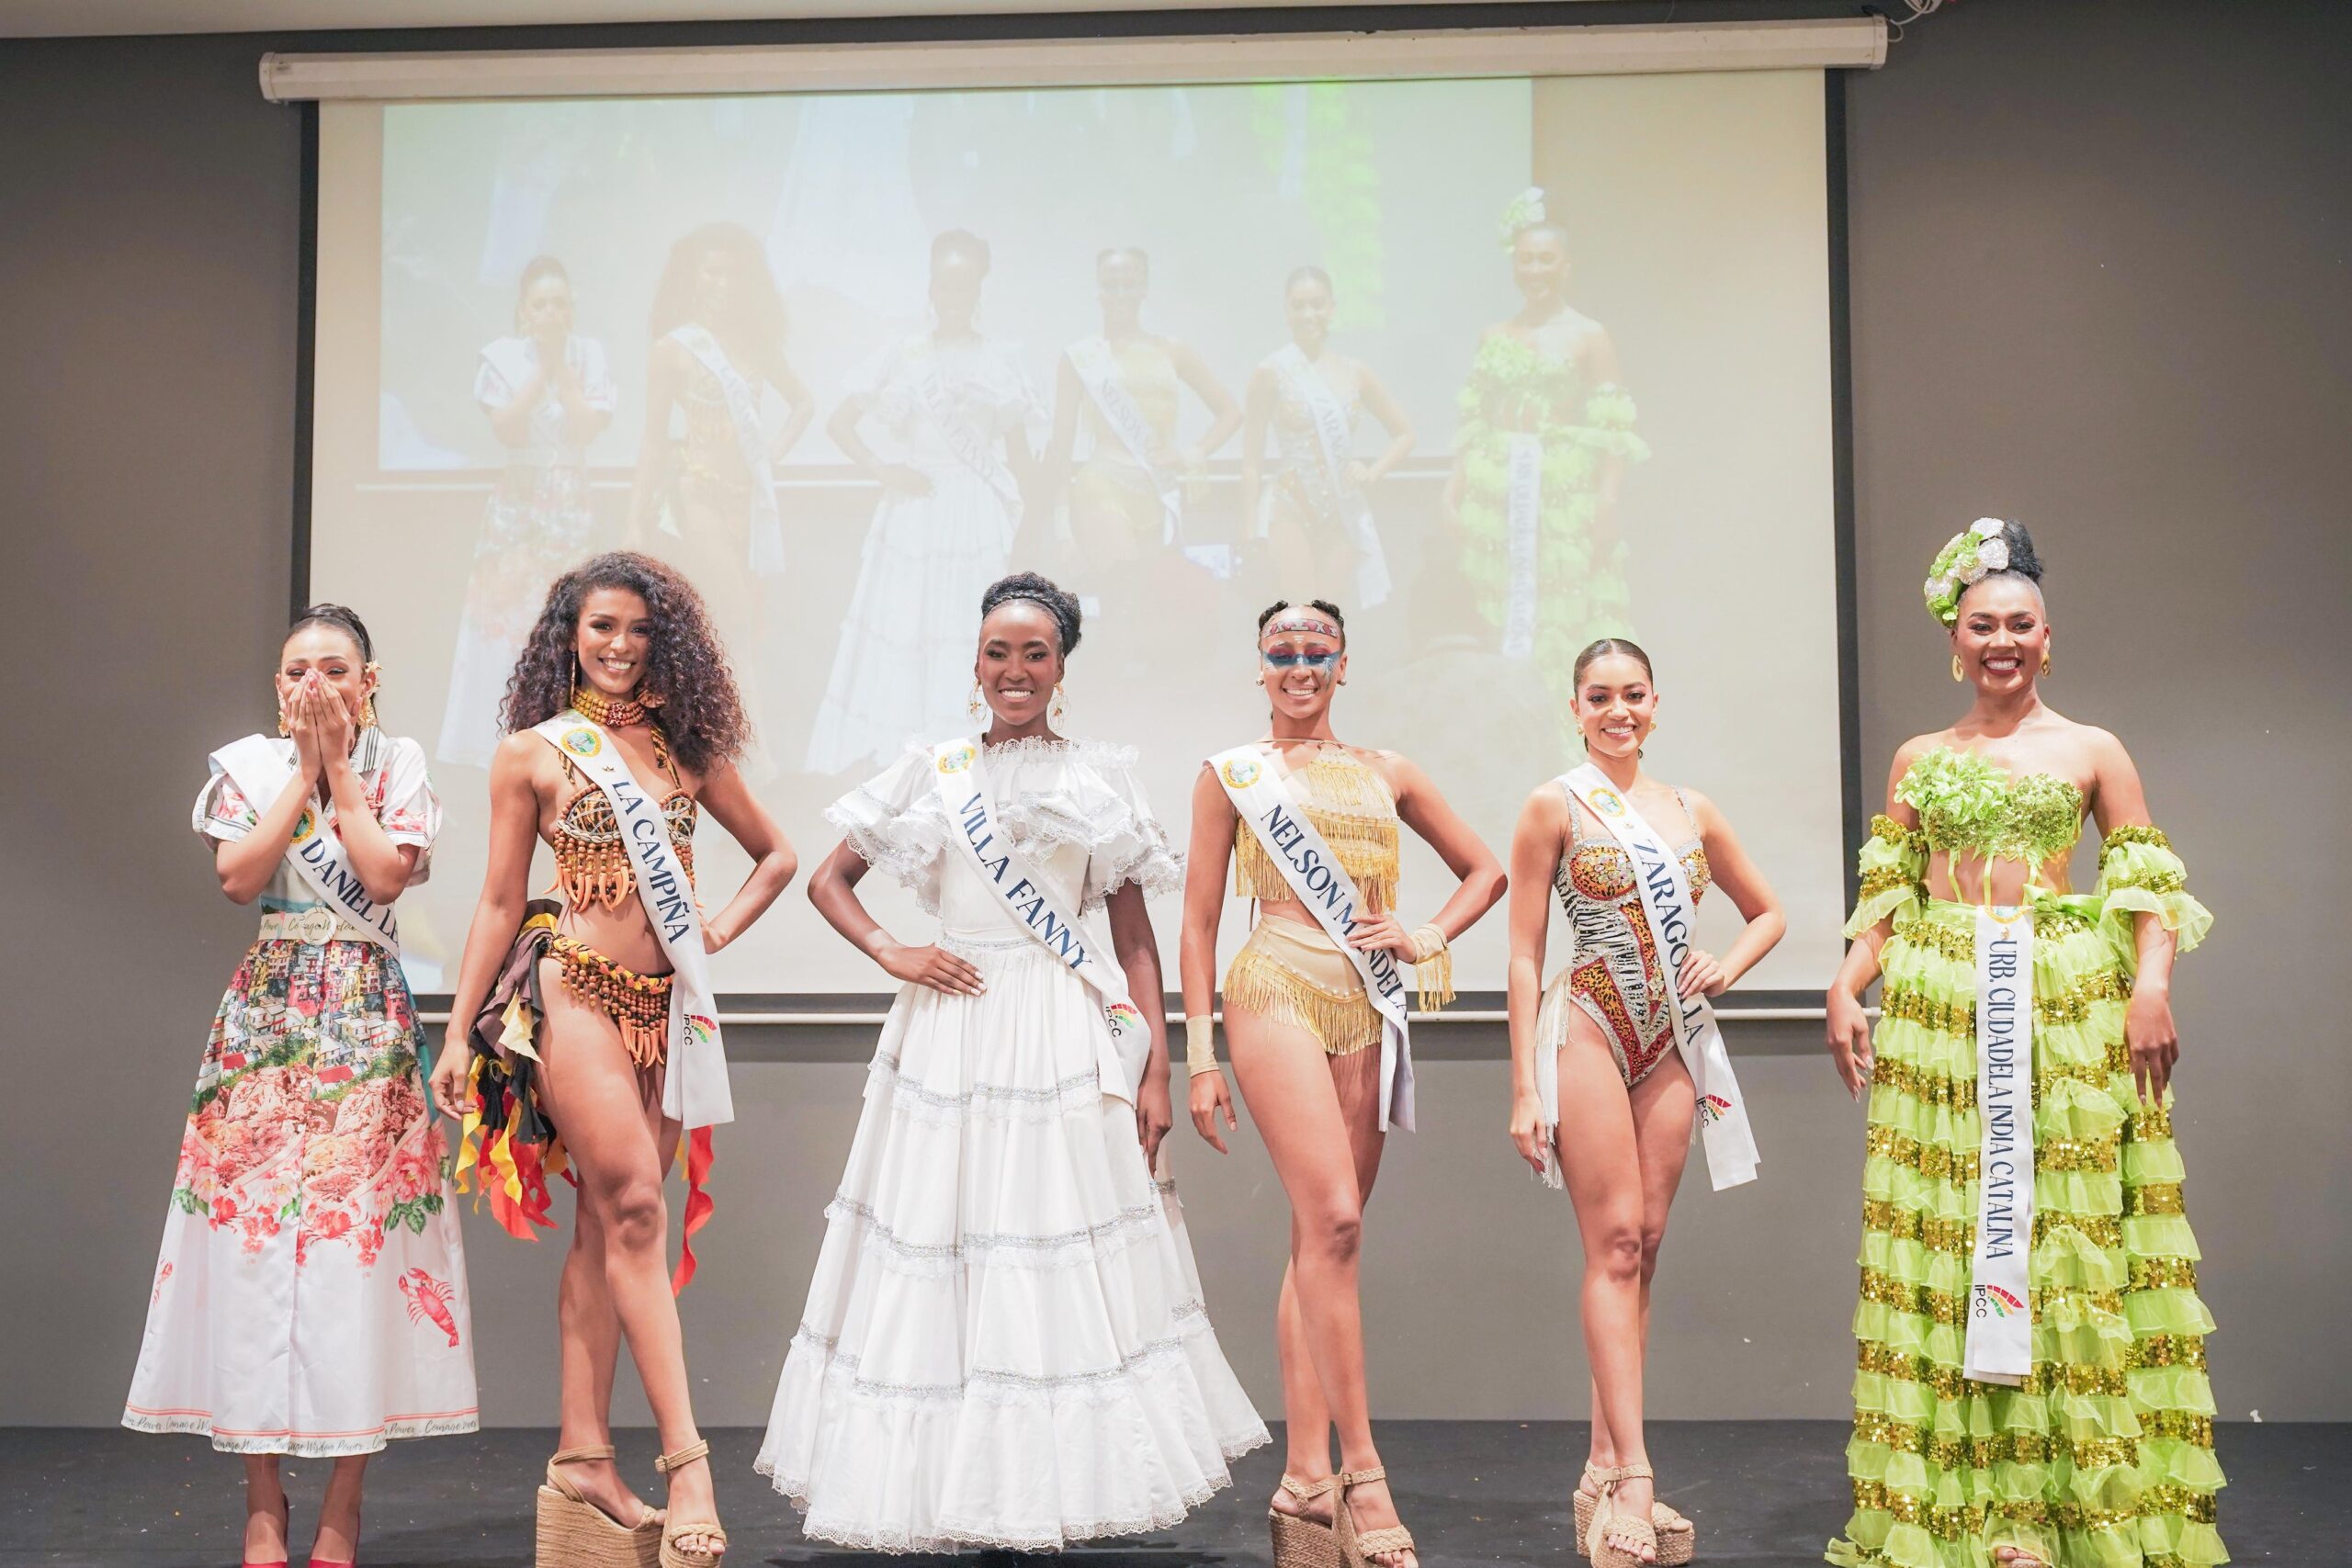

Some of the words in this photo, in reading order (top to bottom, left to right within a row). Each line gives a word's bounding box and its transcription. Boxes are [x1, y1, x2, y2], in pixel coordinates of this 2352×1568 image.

[300, 838, 373, 923] DANIEL
[612, 781, 644, 816] LA
[632, 818, 690, 944] CAMPIÑA
[959, 792, 1010, 884] VILLA
[1005, 877, 1092, 970] FANNY
[1260, 804, 1346, 909] NELSON
[1333, 902, 1408, 1022] MNDELA
[1633, 839, 1704, 1047] ZARAGOLA
[1988, 941, 2018, 983] URB.
[684, 1013, 693, 1045] IPCC
[1105, 1006, 1122, 1038] IPCC
[1987, 987, 2016, 1100] CIUDADELA
[1696, 1096, 1709, 1129] IPCC
[1988, 1104, 2014, 1156] INDIA
[1985, 1161, 2014, 1259] CATALINA
[1974, 1284, 1987, 1318] IPCC
